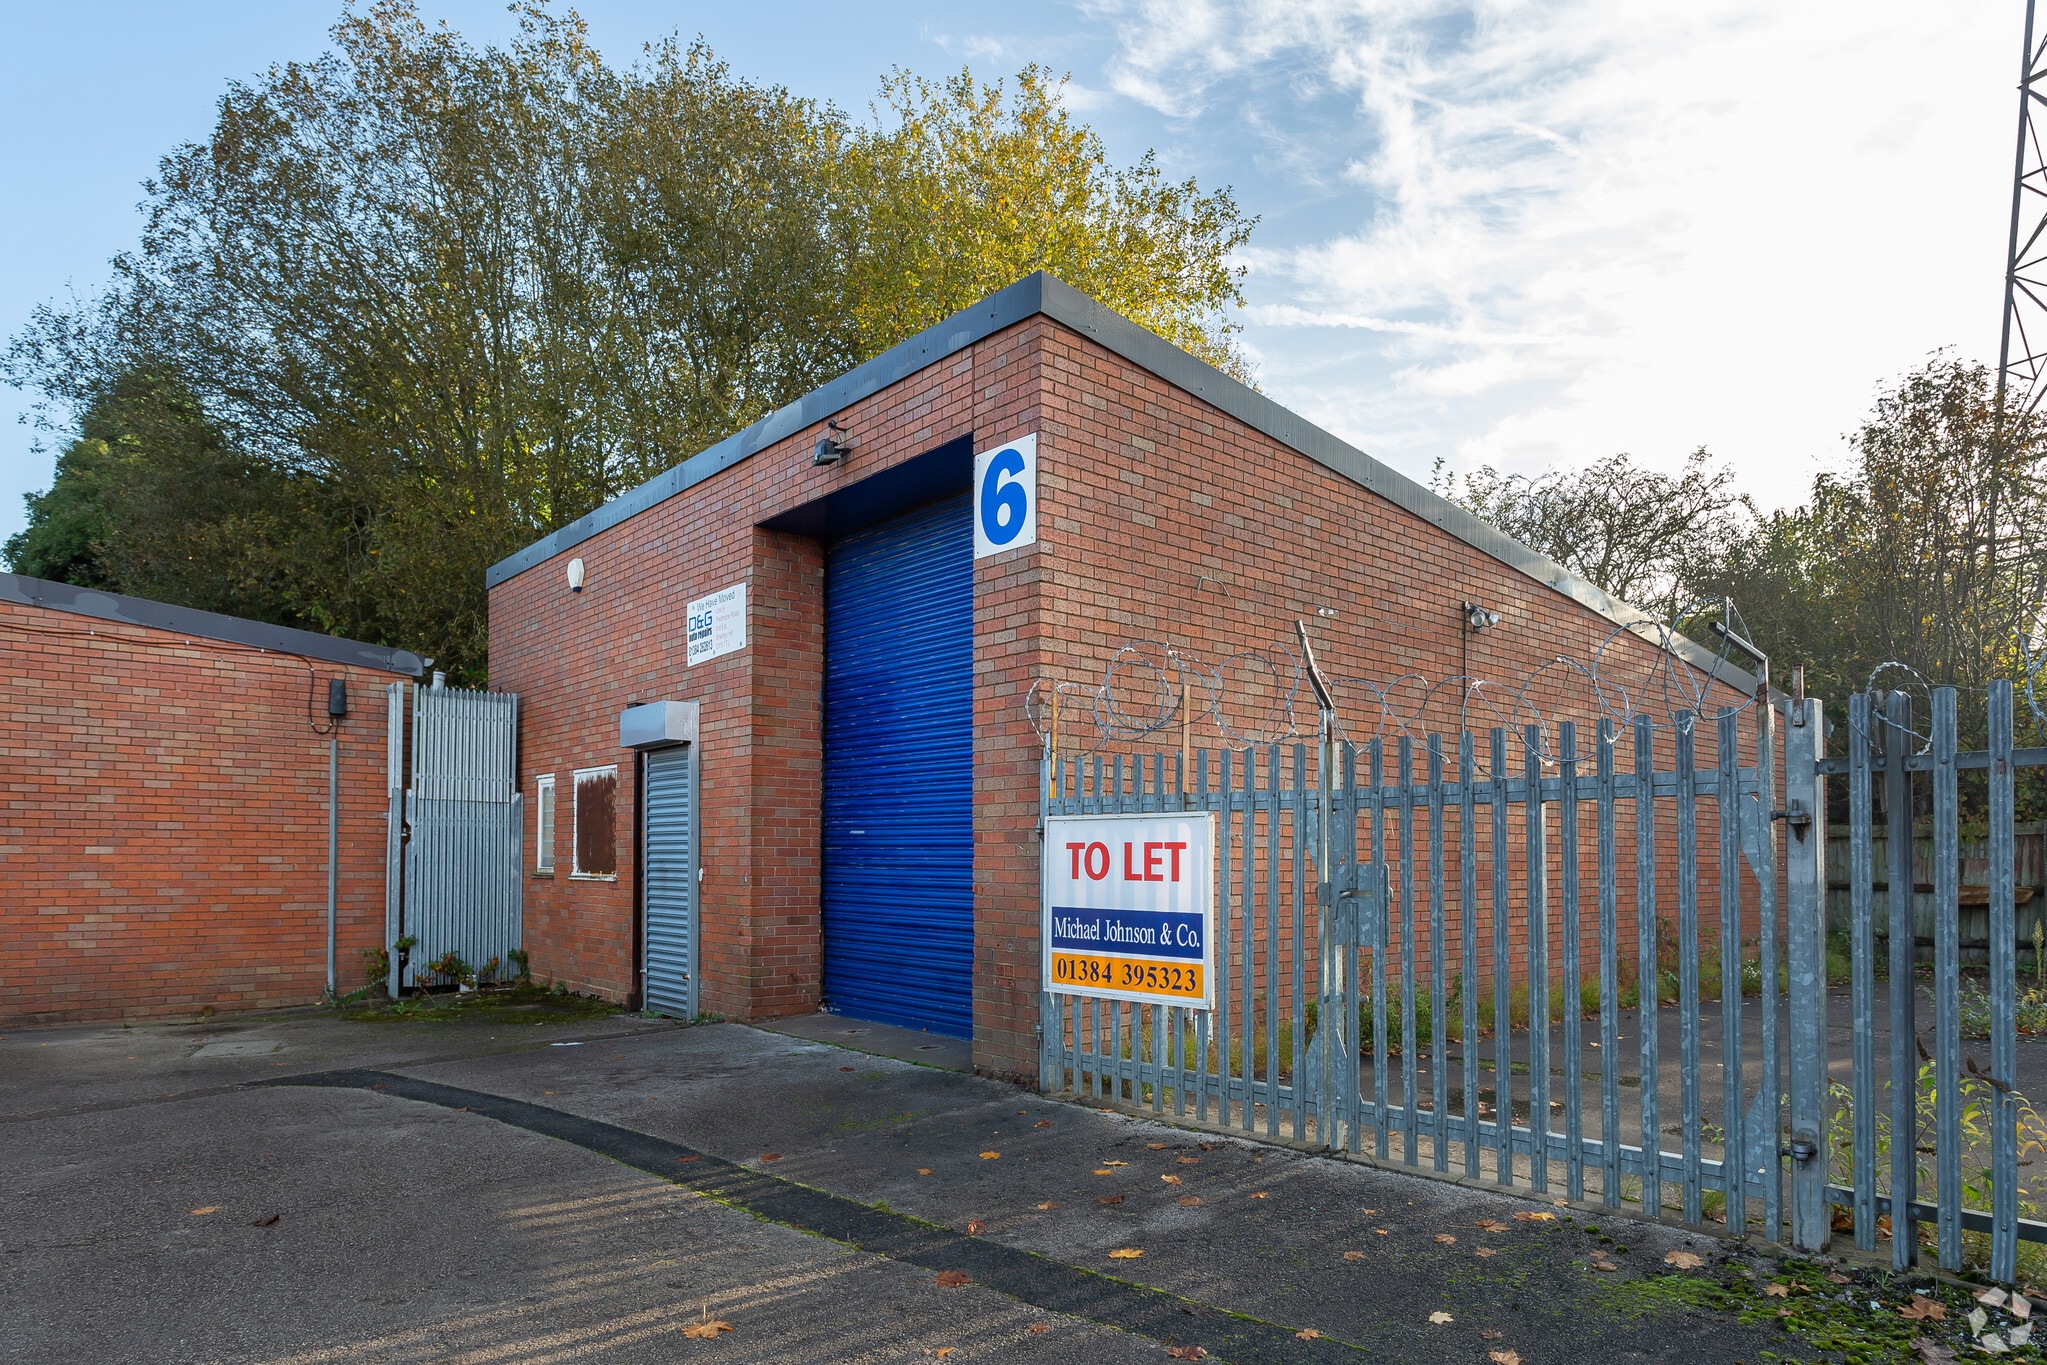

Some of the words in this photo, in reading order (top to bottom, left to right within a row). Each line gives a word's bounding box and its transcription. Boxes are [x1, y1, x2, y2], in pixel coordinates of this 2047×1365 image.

[981, 448, 1027, 545] 6
[697, 602, 705, 612] We
[705, 597, 718, 609] Have
[718, 590, 735, 605] Moved
[689, 610, 713, 633] D&G
[689, 632, 698, 643] auto
[698, 627, 713, 640] repairs
[1066, 841, 1111, 881] TO
[1124, 841, 1187, 882] LET
[1054, 917, 1101, 941] Michael
[1104, 919, 1156, 945] Johnson
[1160, 922, 1173, 946] &
[1176, 923, 1200, 948] Co.
[1057, 957, 1112, 983] 01384
[1122, 963, 1197, 992] 395323
